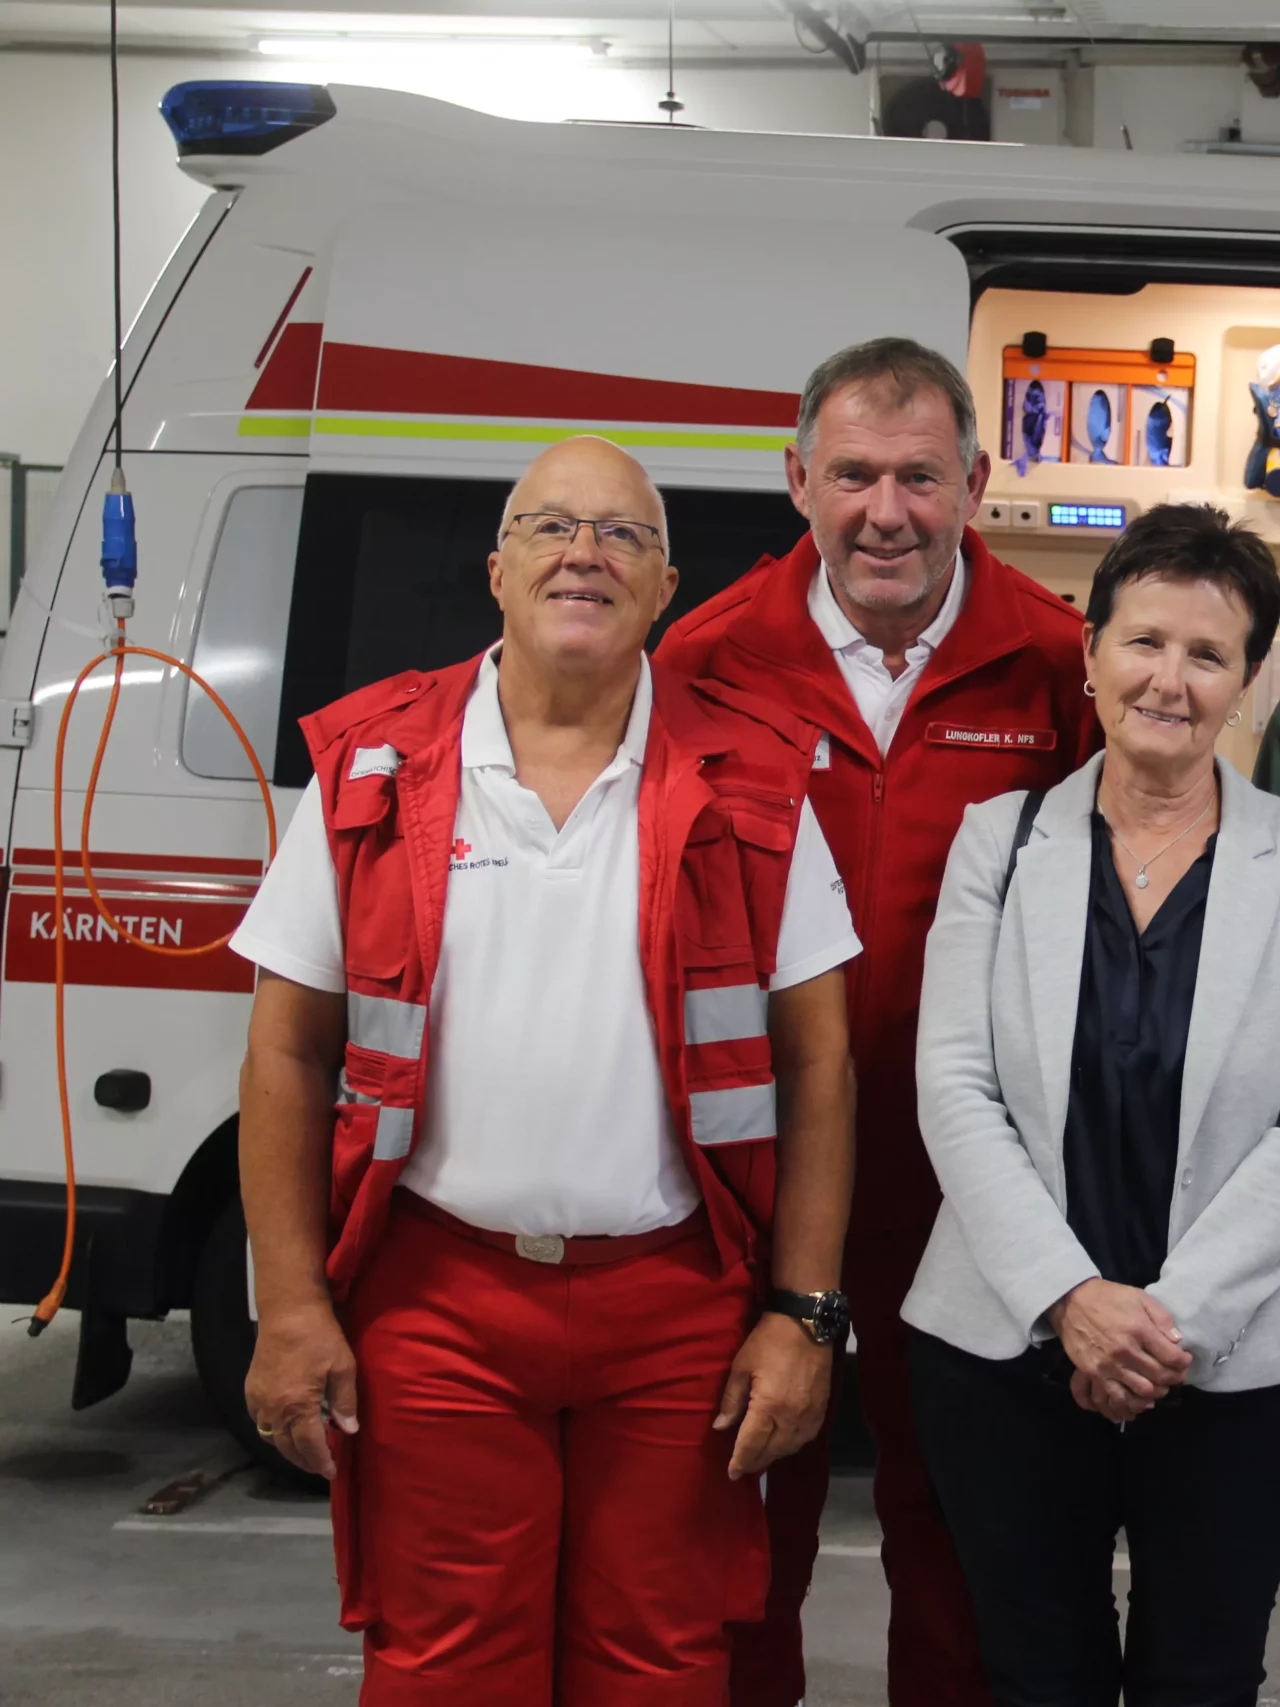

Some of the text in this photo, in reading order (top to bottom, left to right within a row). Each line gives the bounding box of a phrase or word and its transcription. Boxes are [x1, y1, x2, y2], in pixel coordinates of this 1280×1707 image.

[945, 729, 1035, 744] LUNGKOFLER K. NFS
[30, 907, 183, 946] KÄRNTEN
